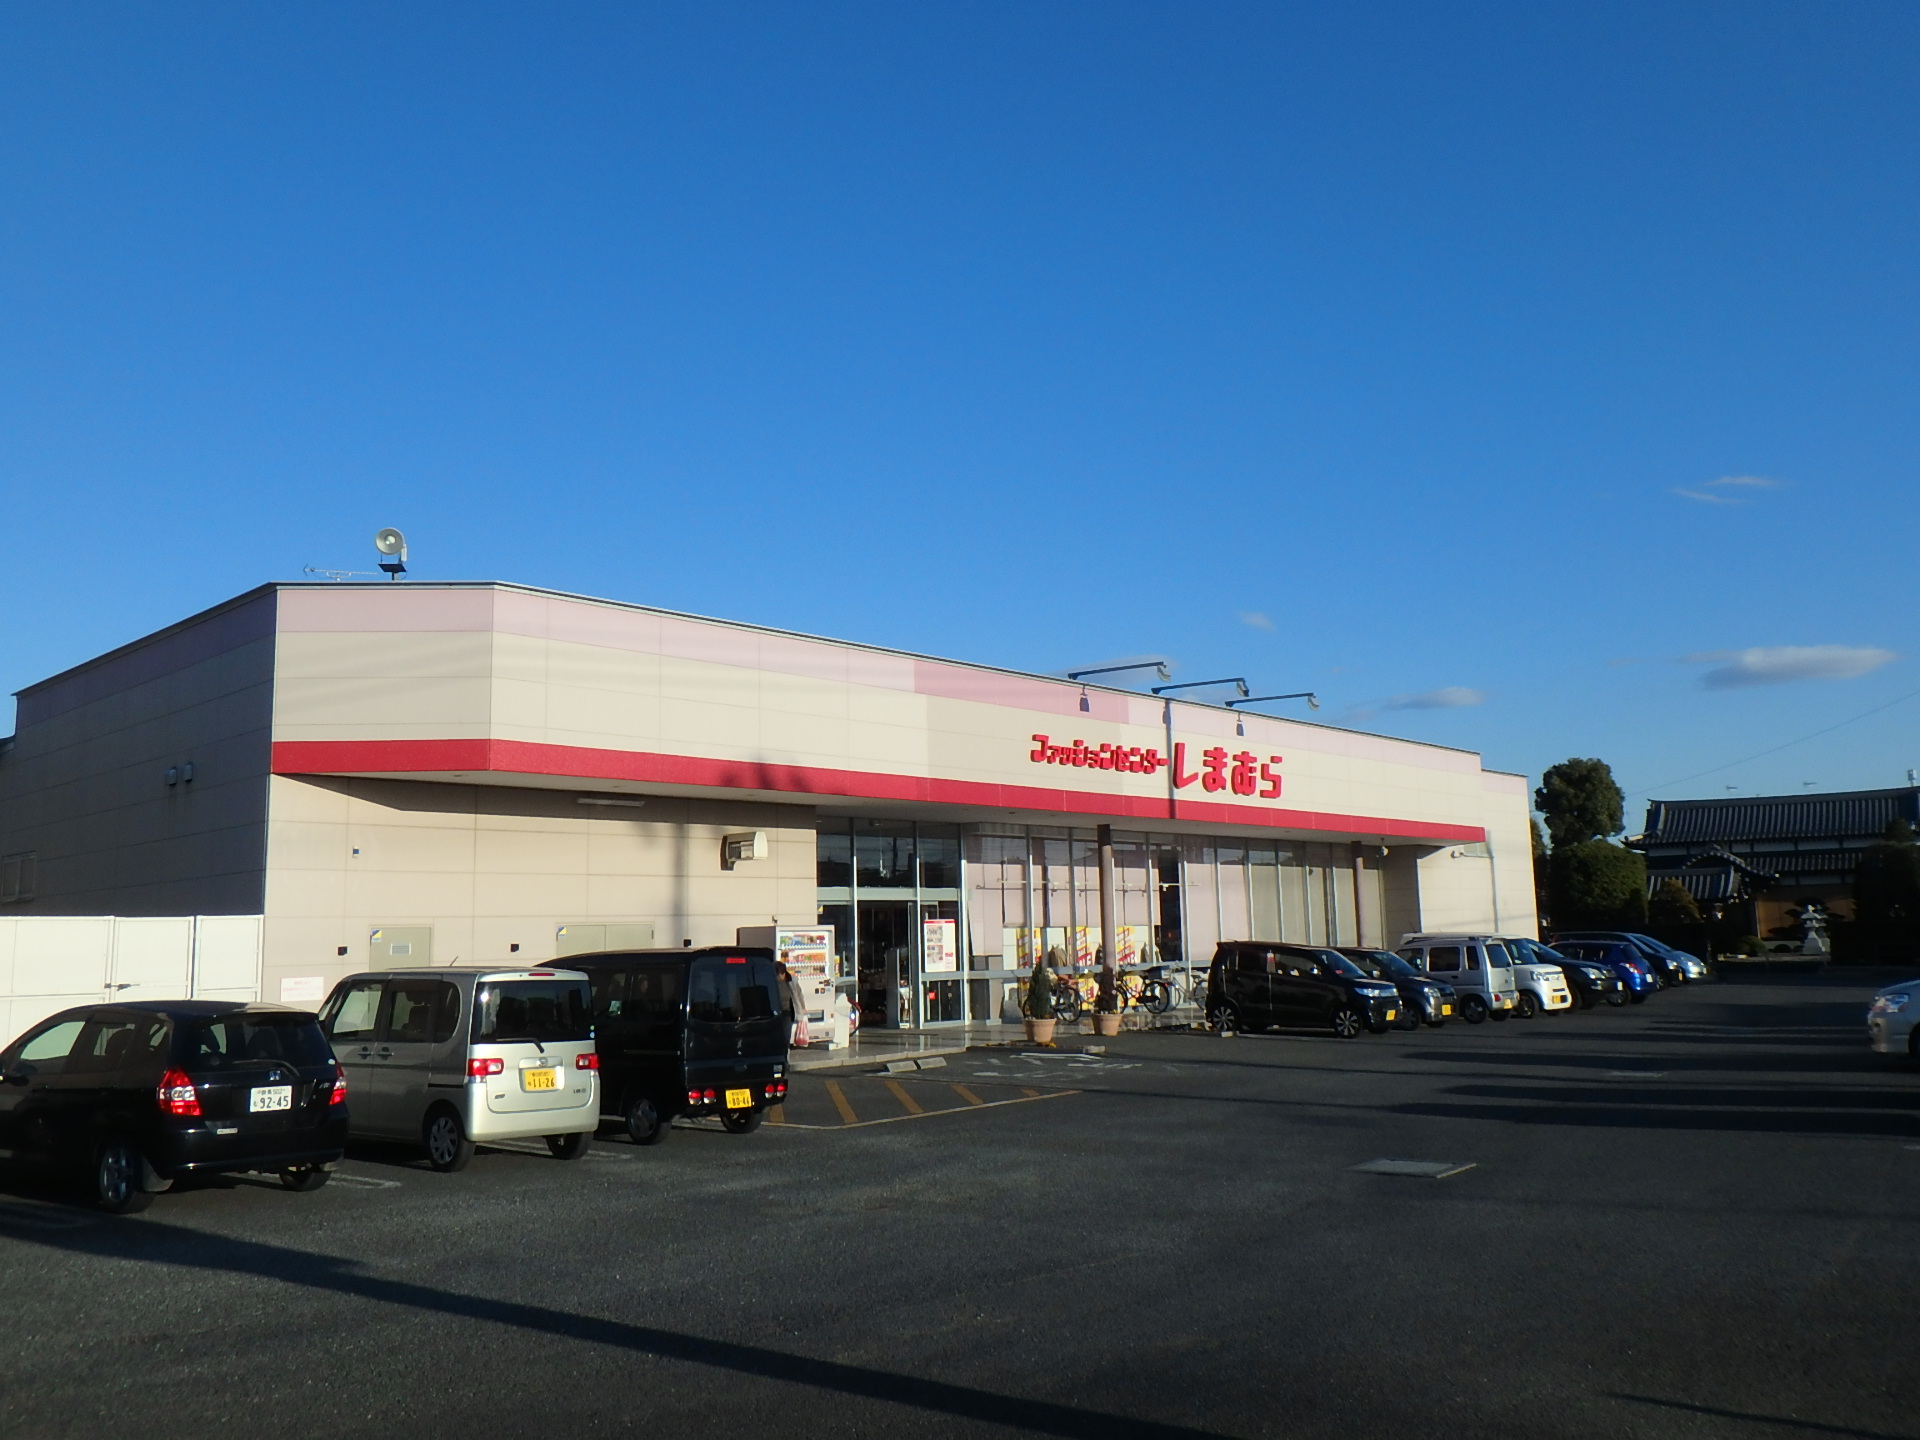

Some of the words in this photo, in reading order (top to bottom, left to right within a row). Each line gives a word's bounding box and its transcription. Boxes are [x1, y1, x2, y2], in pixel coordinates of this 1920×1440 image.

[1031, 734, 1170, 774] ファッションセンター
[1173, 742, 1283, 799] しまむら
